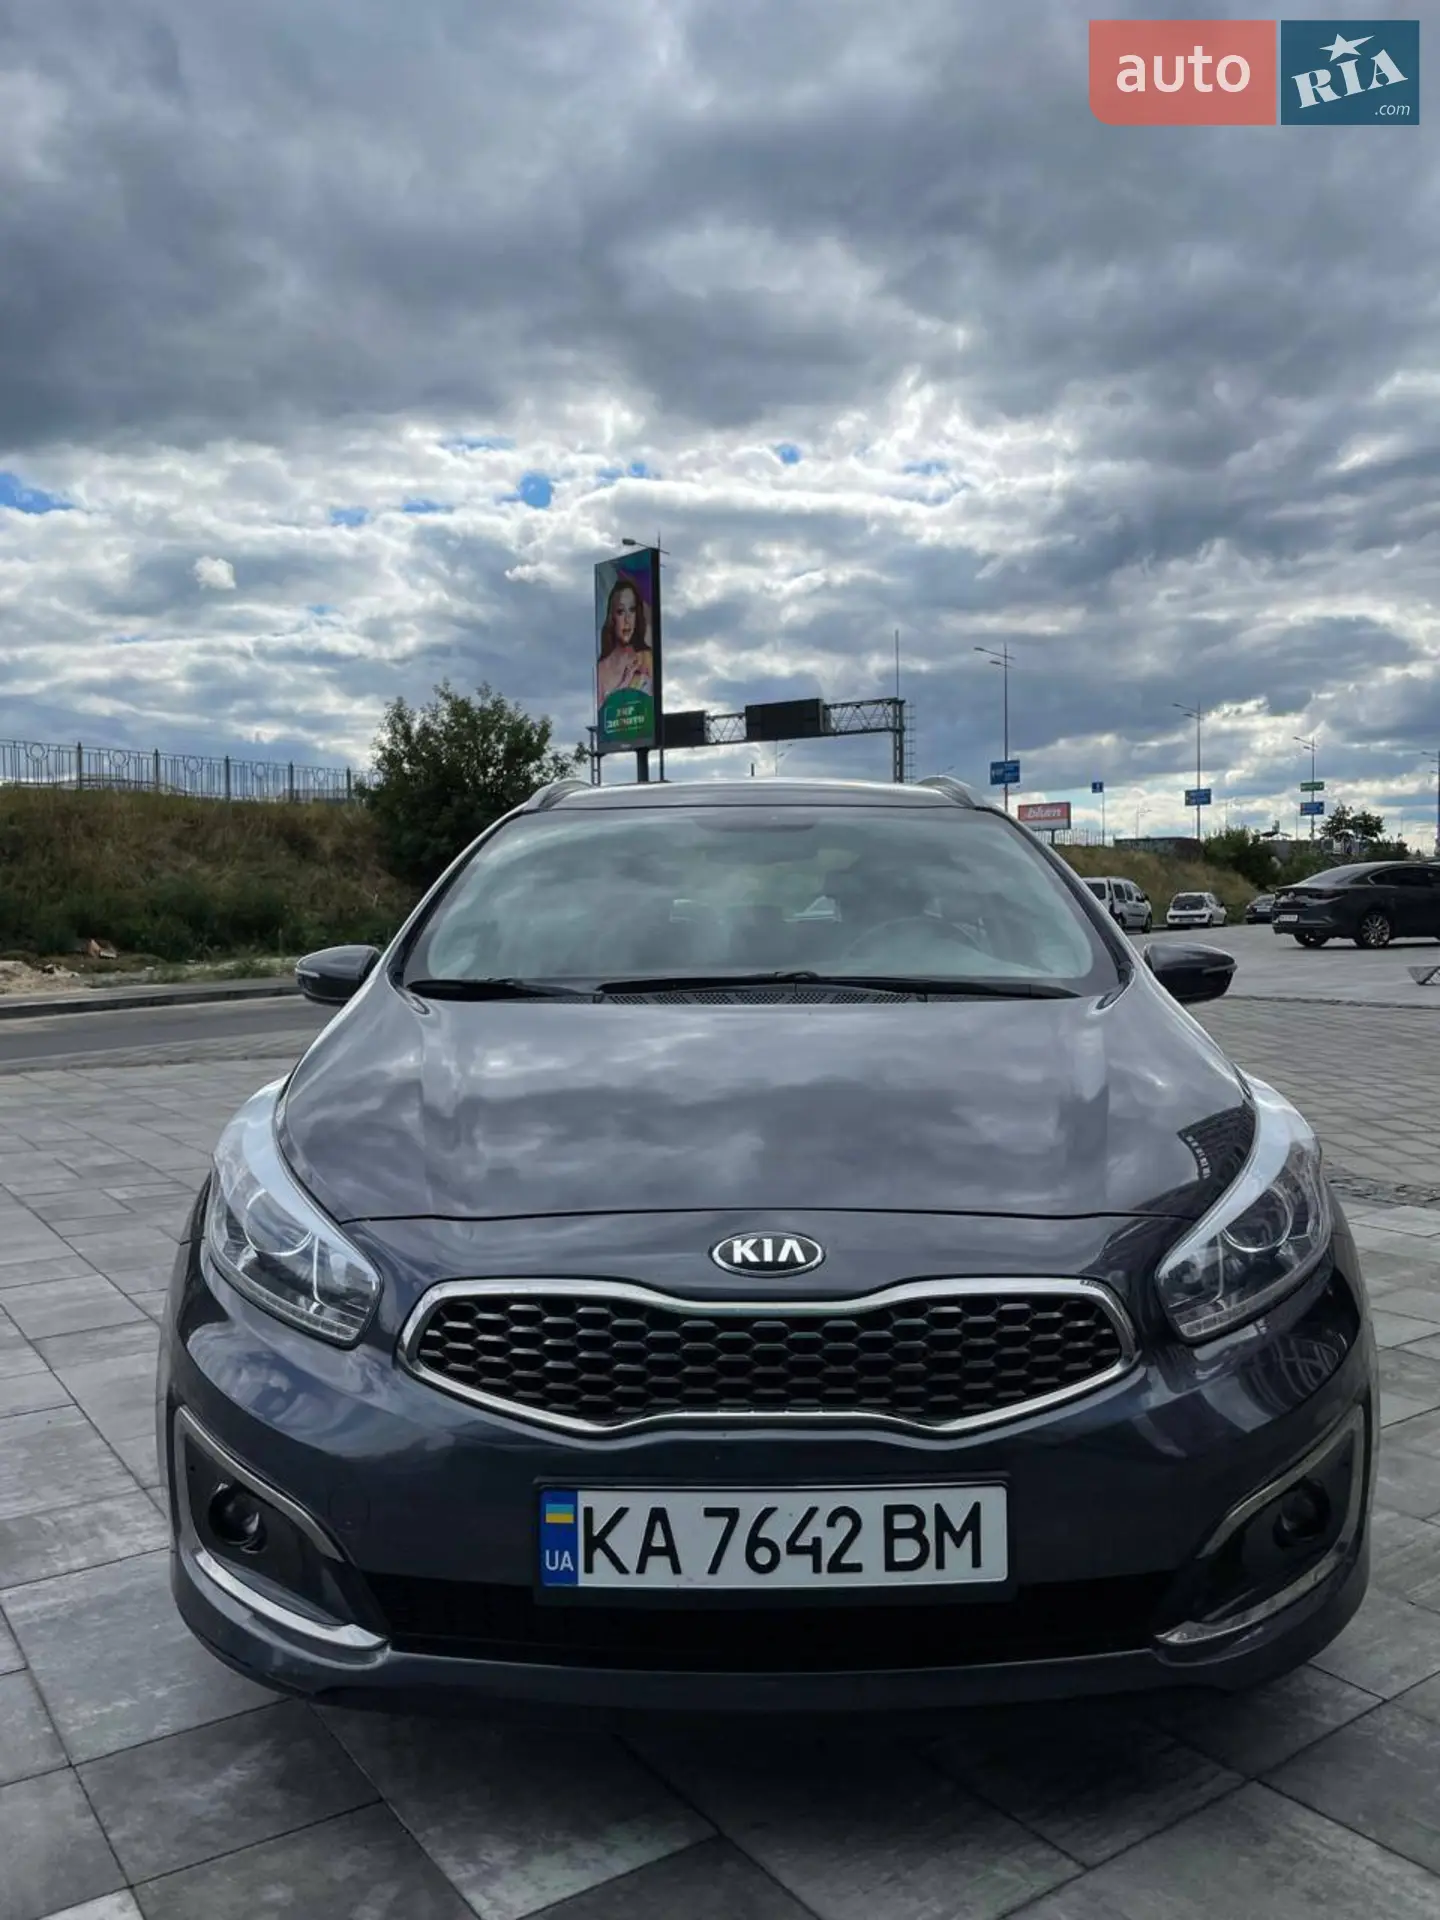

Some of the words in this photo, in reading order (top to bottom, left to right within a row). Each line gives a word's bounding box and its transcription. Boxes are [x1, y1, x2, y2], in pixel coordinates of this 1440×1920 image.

[732, 1238, 806, 1264] KIA
[583, 1506, 683, 1576] KA
[703, 1505, 863, 1576] 7642
[883, 1501, 982, 1572] BM
[545, 1550, 574, 1572] UA
